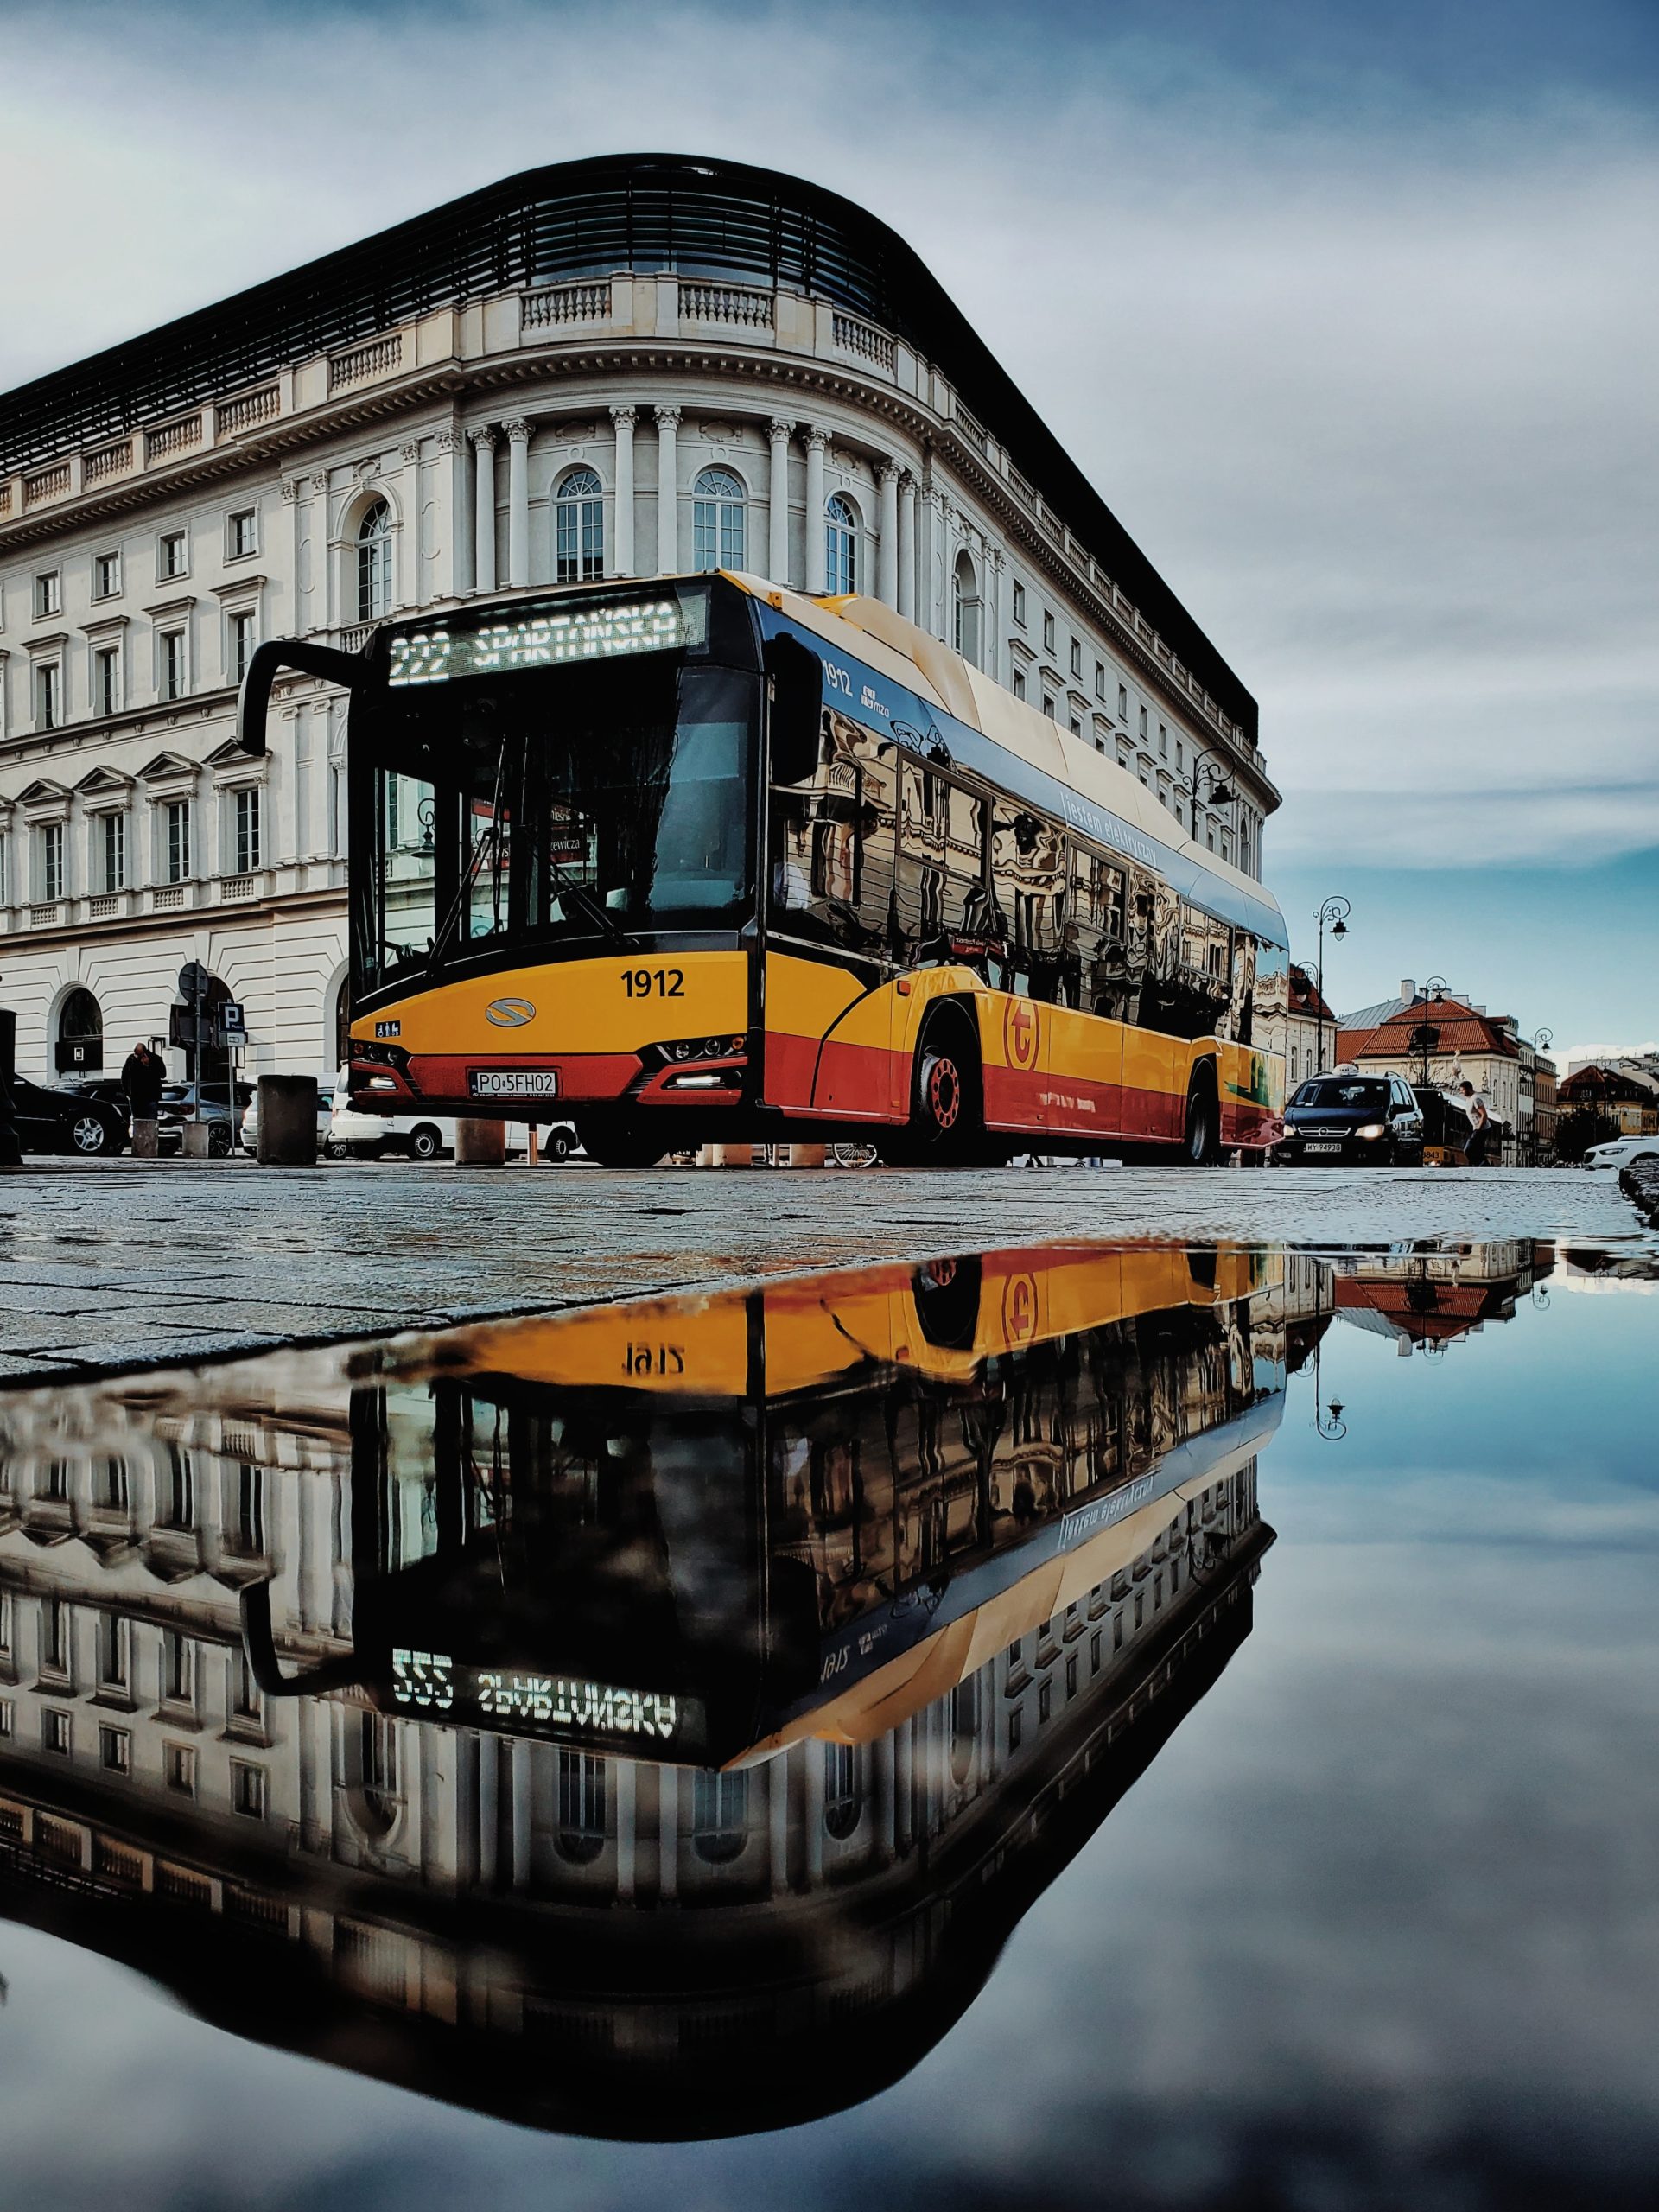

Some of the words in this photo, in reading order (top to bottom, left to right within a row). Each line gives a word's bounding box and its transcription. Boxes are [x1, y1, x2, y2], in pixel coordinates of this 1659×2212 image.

[388, 631, 450, 687] 222
[823, 659, 853, 698] 1912
[1065, 793, 1103, 835] jestem
[1104, 817, 1158, 868] elektryczny
[620, 969, 685, 998] 1912
[225, 1007, 239, 1028] P
[480, 1074, 501, 1092] PO
[506, 1074, 553, 1092] 5FH02
